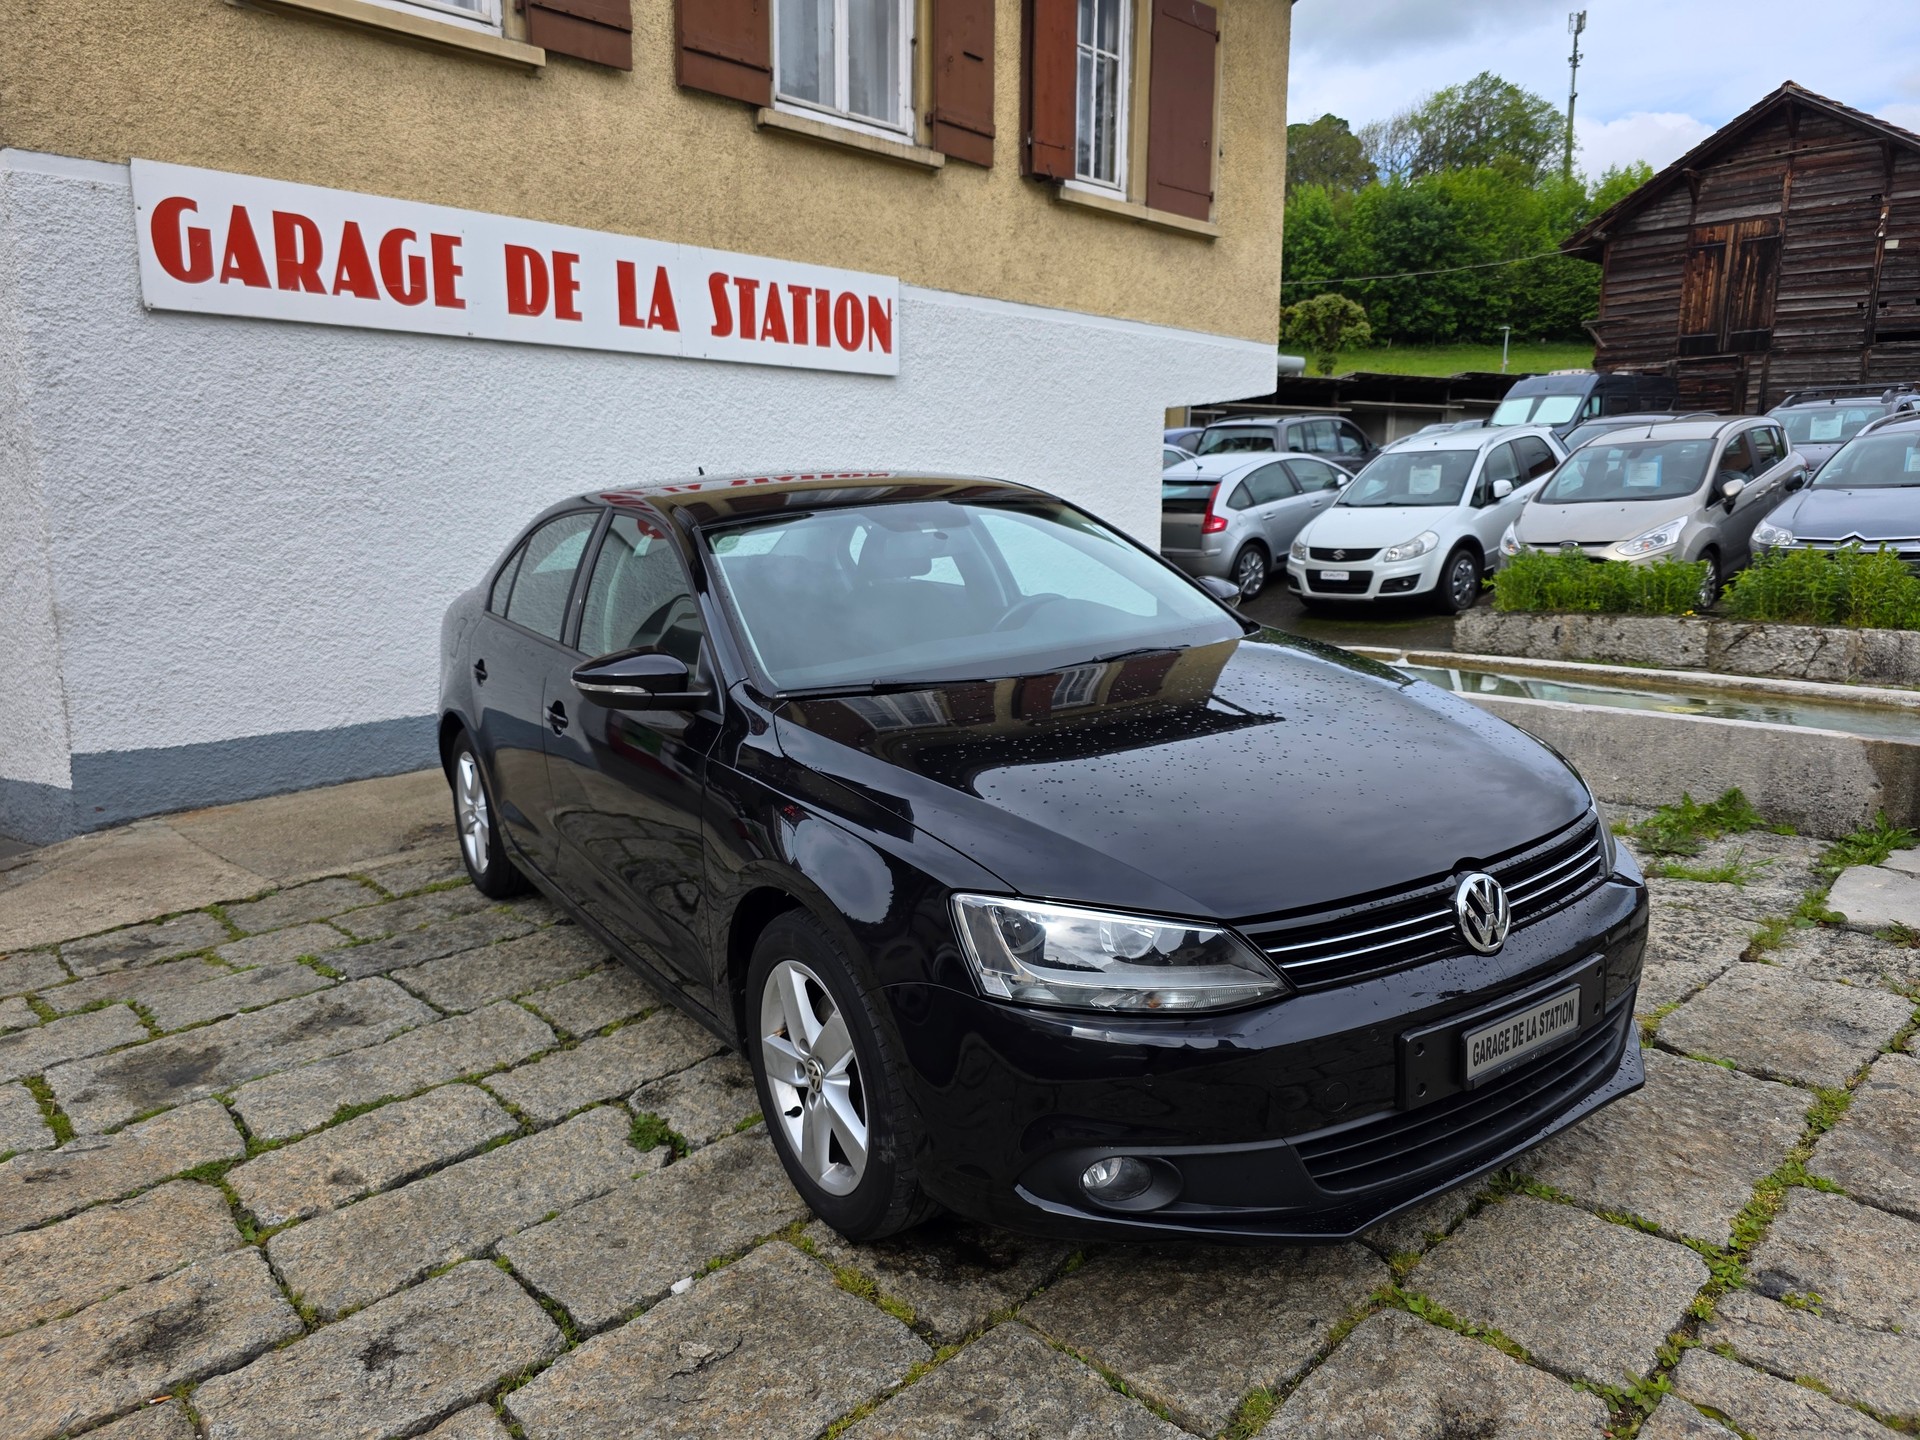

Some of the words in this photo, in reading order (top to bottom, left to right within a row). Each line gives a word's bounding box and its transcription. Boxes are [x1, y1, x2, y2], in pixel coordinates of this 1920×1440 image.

[151, 196, 467, 309] GARAGE
[504, 243, 582, 321] DE
[616, 260, 680, 332] LA
[708, 272, 893, 353] STATION
[1472, 1028, 1511, 1067] GARAGE
[1512, 1021, 1525, 1049] DE
[1526, 1016, 1537, 1043] LA
[1540, 998, 1575, 1037] STATION
